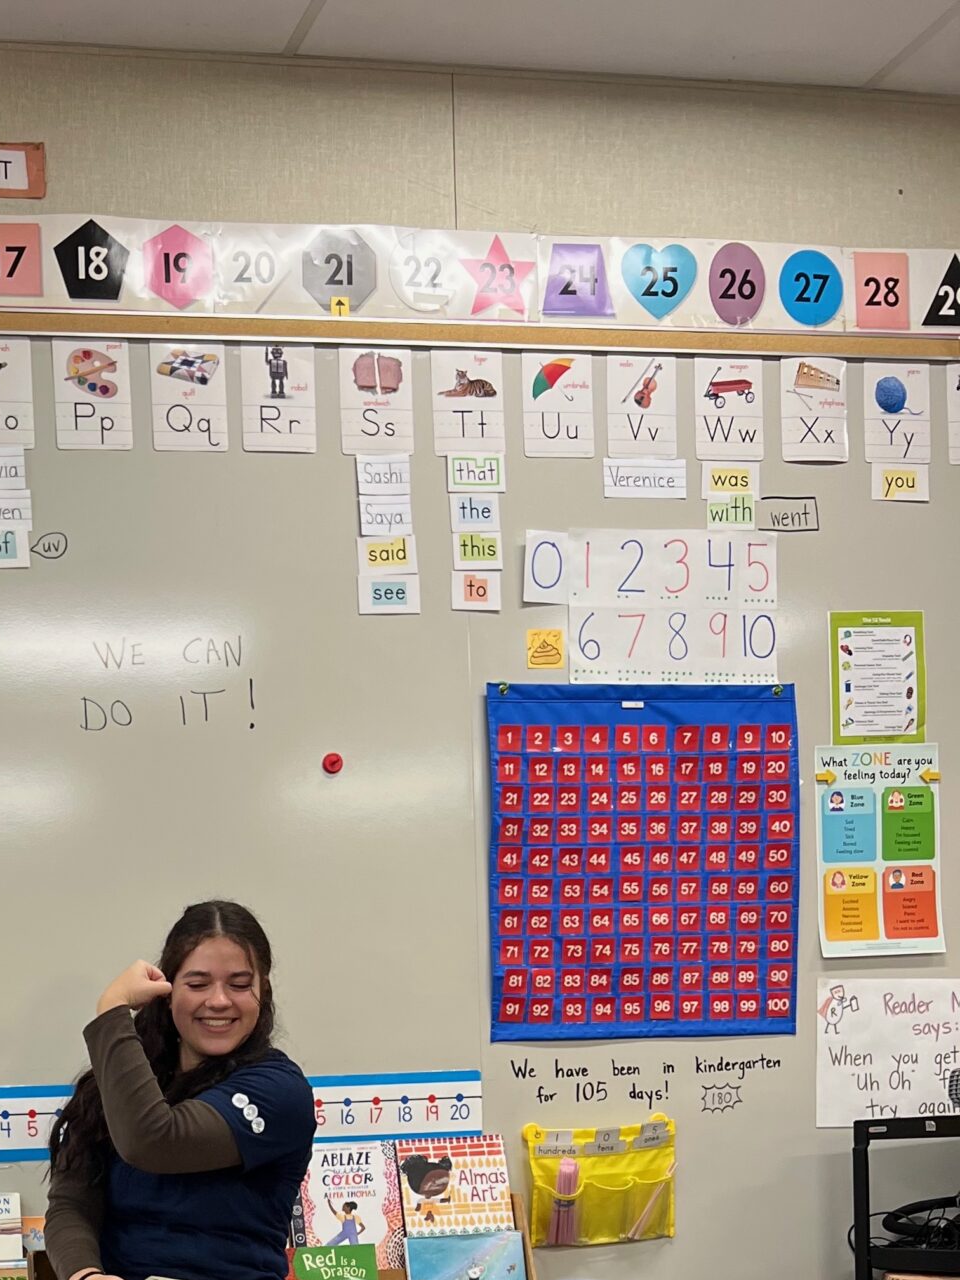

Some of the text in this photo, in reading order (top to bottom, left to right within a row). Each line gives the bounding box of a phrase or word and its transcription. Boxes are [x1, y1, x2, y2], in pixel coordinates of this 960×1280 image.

[76, 245, 111, 281] 18
[793, 271, 831, 305] 27
[363, 462, 403, 484] Sashi
[456, 462, 495, 481] that
[608, 466, 675, 489] Verenice
[712, 472, 749, 488] was
[885, 474, 916, 498] you
[365, 504, 403, 533] Saya
[459, 497, 491, 519] the
[710, 497, 753, 523] with
[770, 503, 811, 527] went
[368, 538, 407, 562] said
[460, 535, 496, 557] this
[373, 587, 406, 601] see
[467, 579, 487, 597] to
[92, 635, 242, 669] WE CAN
[80, 696, 132, 731] DO
[821, 752, 933, 770] What ZONE are you
[843, 768, 911, 784] feeling today?
[681, 912, 697, 924] 67
[883, 992, 933, 1015] Reader
[511, 1053, 781, 1080] We have been in kindergarten
[828, 1045, 918, 1072] When you
[536, 1080, 669, 1110] for 105 days!
[538, 1145, 577, 1156] hundreds
[597, 1143, 615, 1153] tens
[321, 1152, 372, 1167] ABLAZE
[322, 1173, 373, 1187] COLOR
[458, 1168, 507, 1187] Alma's
[470, 1186, 498, 1202] Art
[302, 1250, 337, 1271] Red
[320, 1265, 366, 1280] Dragon
